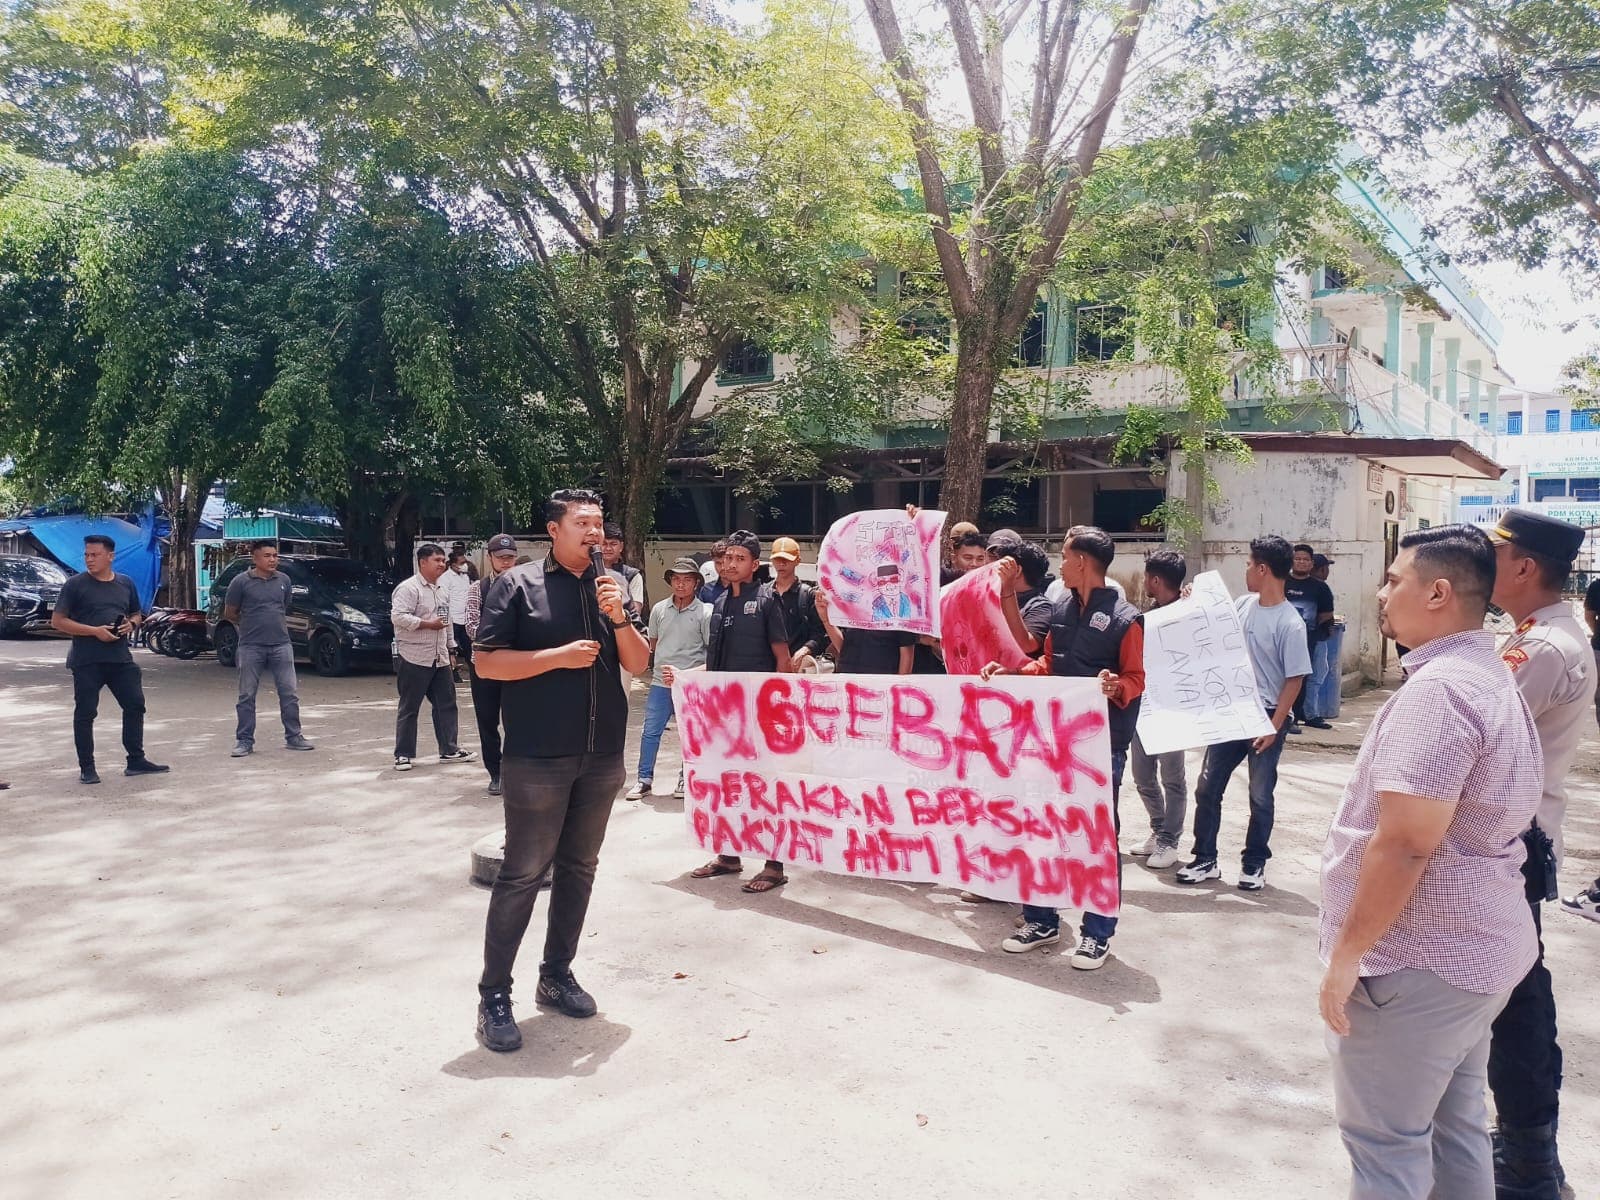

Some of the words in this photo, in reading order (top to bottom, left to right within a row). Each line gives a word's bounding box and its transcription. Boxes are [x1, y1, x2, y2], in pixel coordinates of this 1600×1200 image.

[688, 769, 895, 828] GERAKAN
[692, 806, 833, 864] RAKYAT
[842, 827, 942, 876] ANTI
